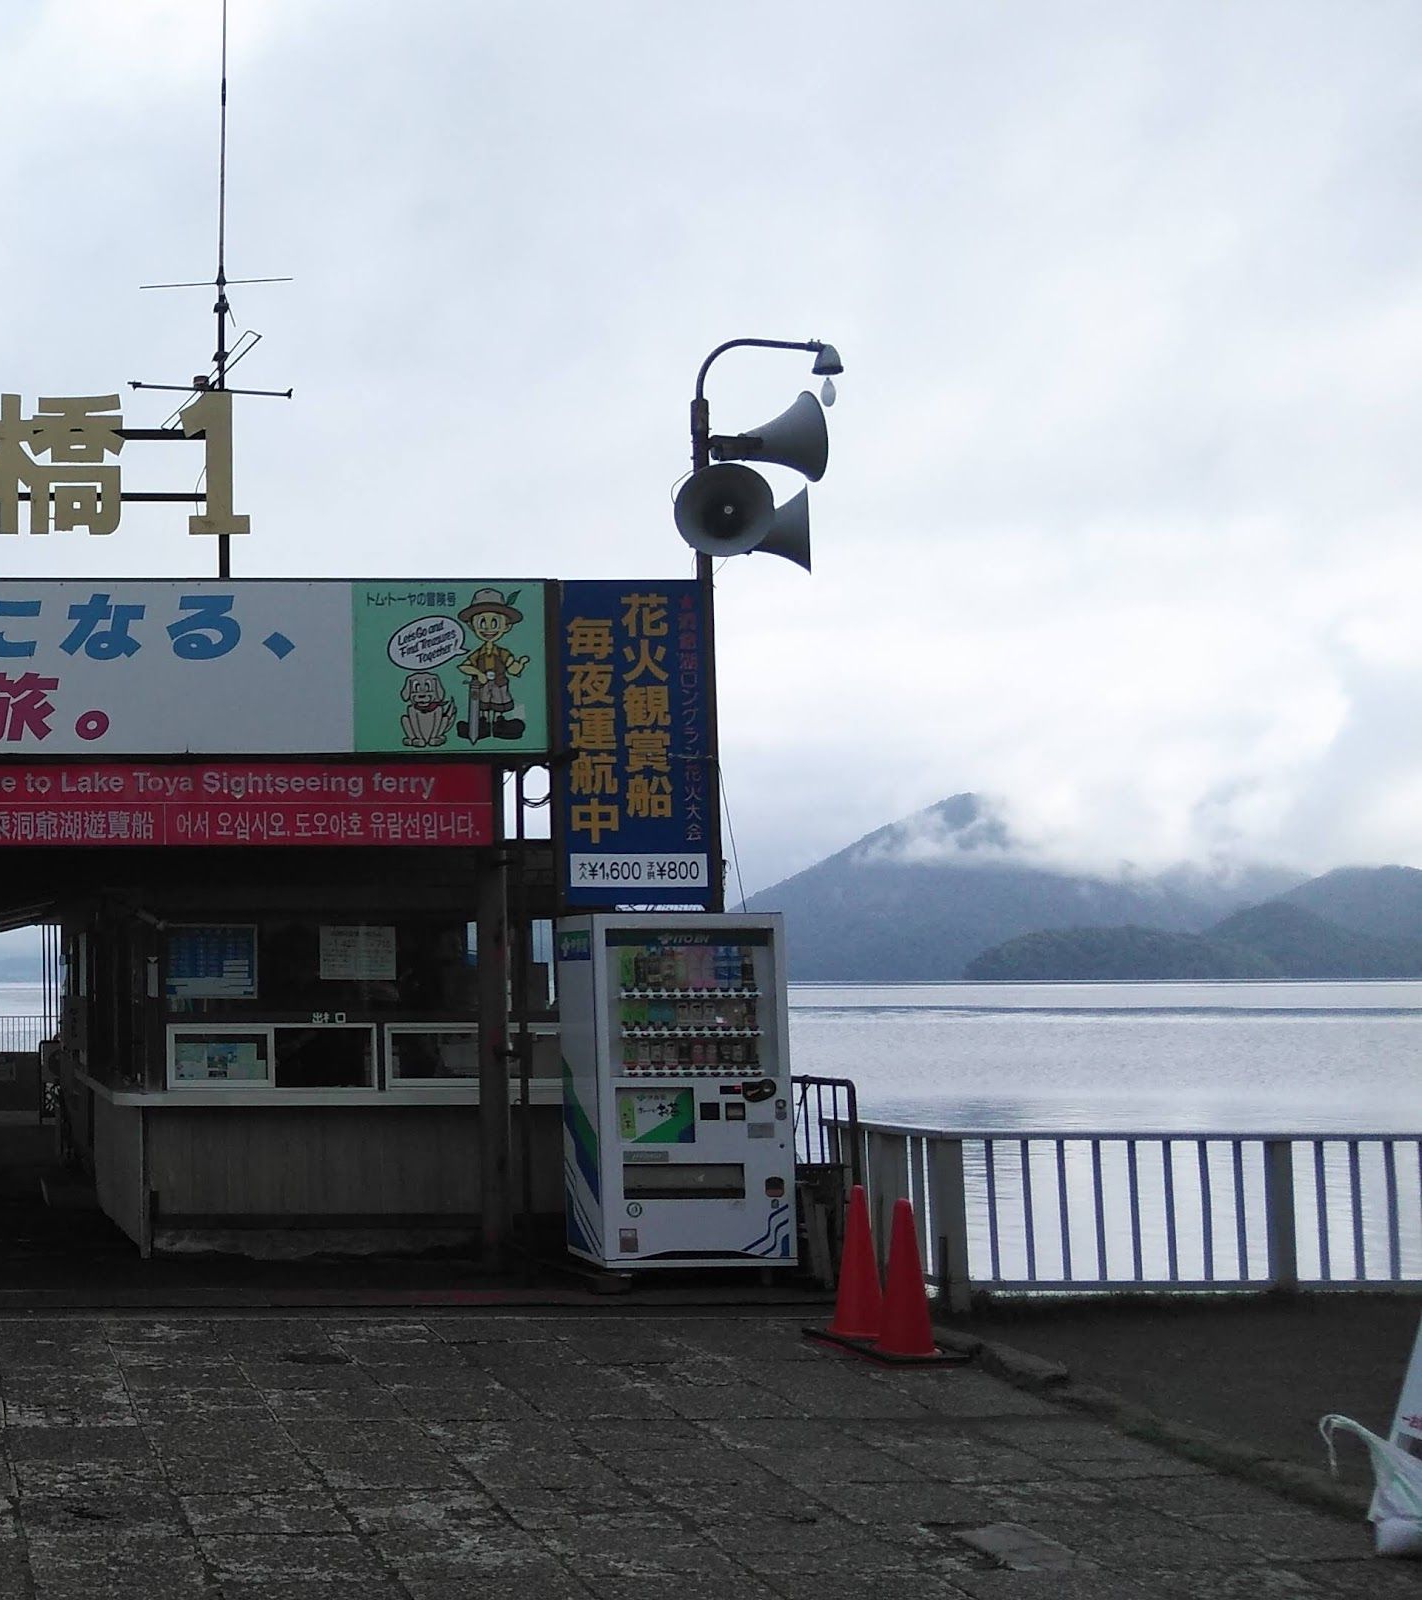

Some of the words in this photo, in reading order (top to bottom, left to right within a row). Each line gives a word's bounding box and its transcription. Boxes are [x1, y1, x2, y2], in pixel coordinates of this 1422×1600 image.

[620, 592, 673, 819] 花火観賞船
[566, 616, 620, 845] 毎夜運航中
[25, 773, 51, 794] to
[61, 771, 125, 793] Lake
[133, 772, 194, 797] Toya
[202, 771, 365, 799] Sightseeing
[373, 772, 436, 800] ferry
[177, 810, 210, 839] 어서
[294, 811, 364, 838] 도오야호
[656, 861, 699, 880] ¥800
